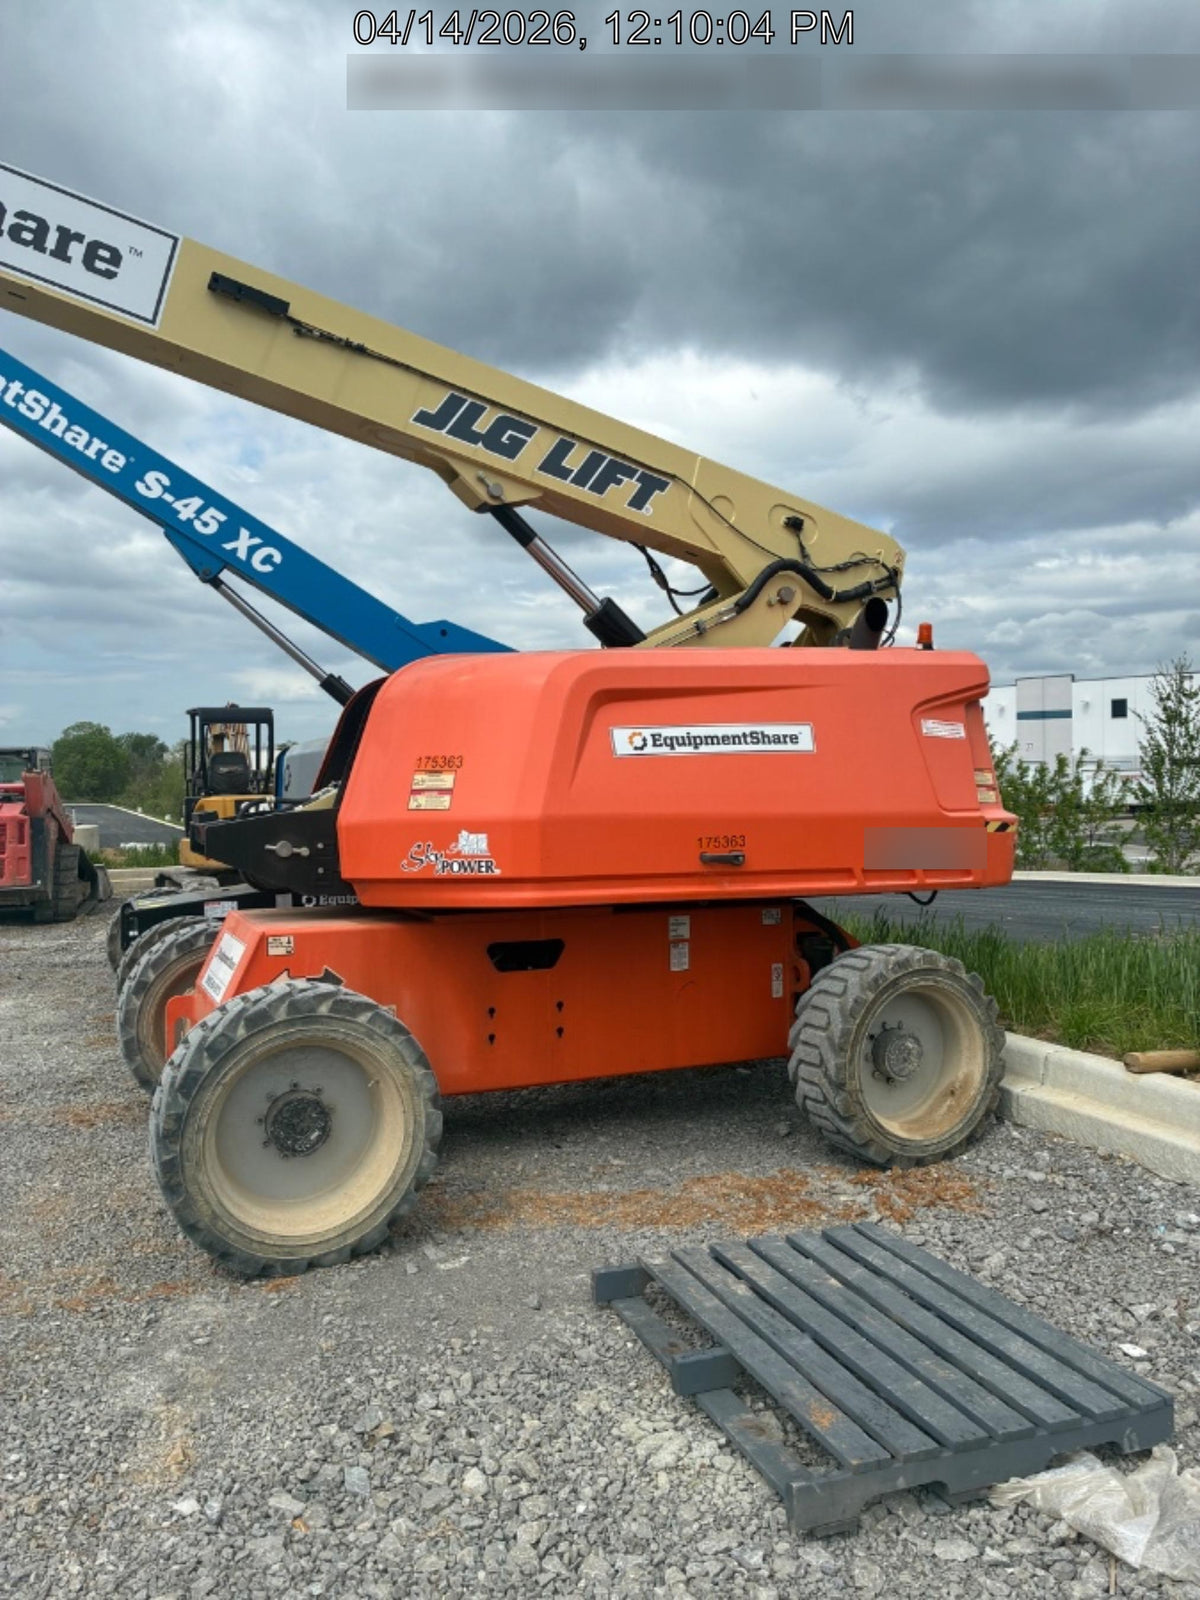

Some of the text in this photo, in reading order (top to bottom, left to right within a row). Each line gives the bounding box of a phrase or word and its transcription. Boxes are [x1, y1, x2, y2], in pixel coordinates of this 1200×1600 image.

[409, 390, 541, 462] JLG
[134, 470, 228, 535] S-45
[221, 527, 283, 573] XC
[650, 731, 799, 750] EquipmentShare
[416, 755, 464, 769] 175363
[697, 834, 746, 849] 175363
[440, 859, 497, 875] POWER
